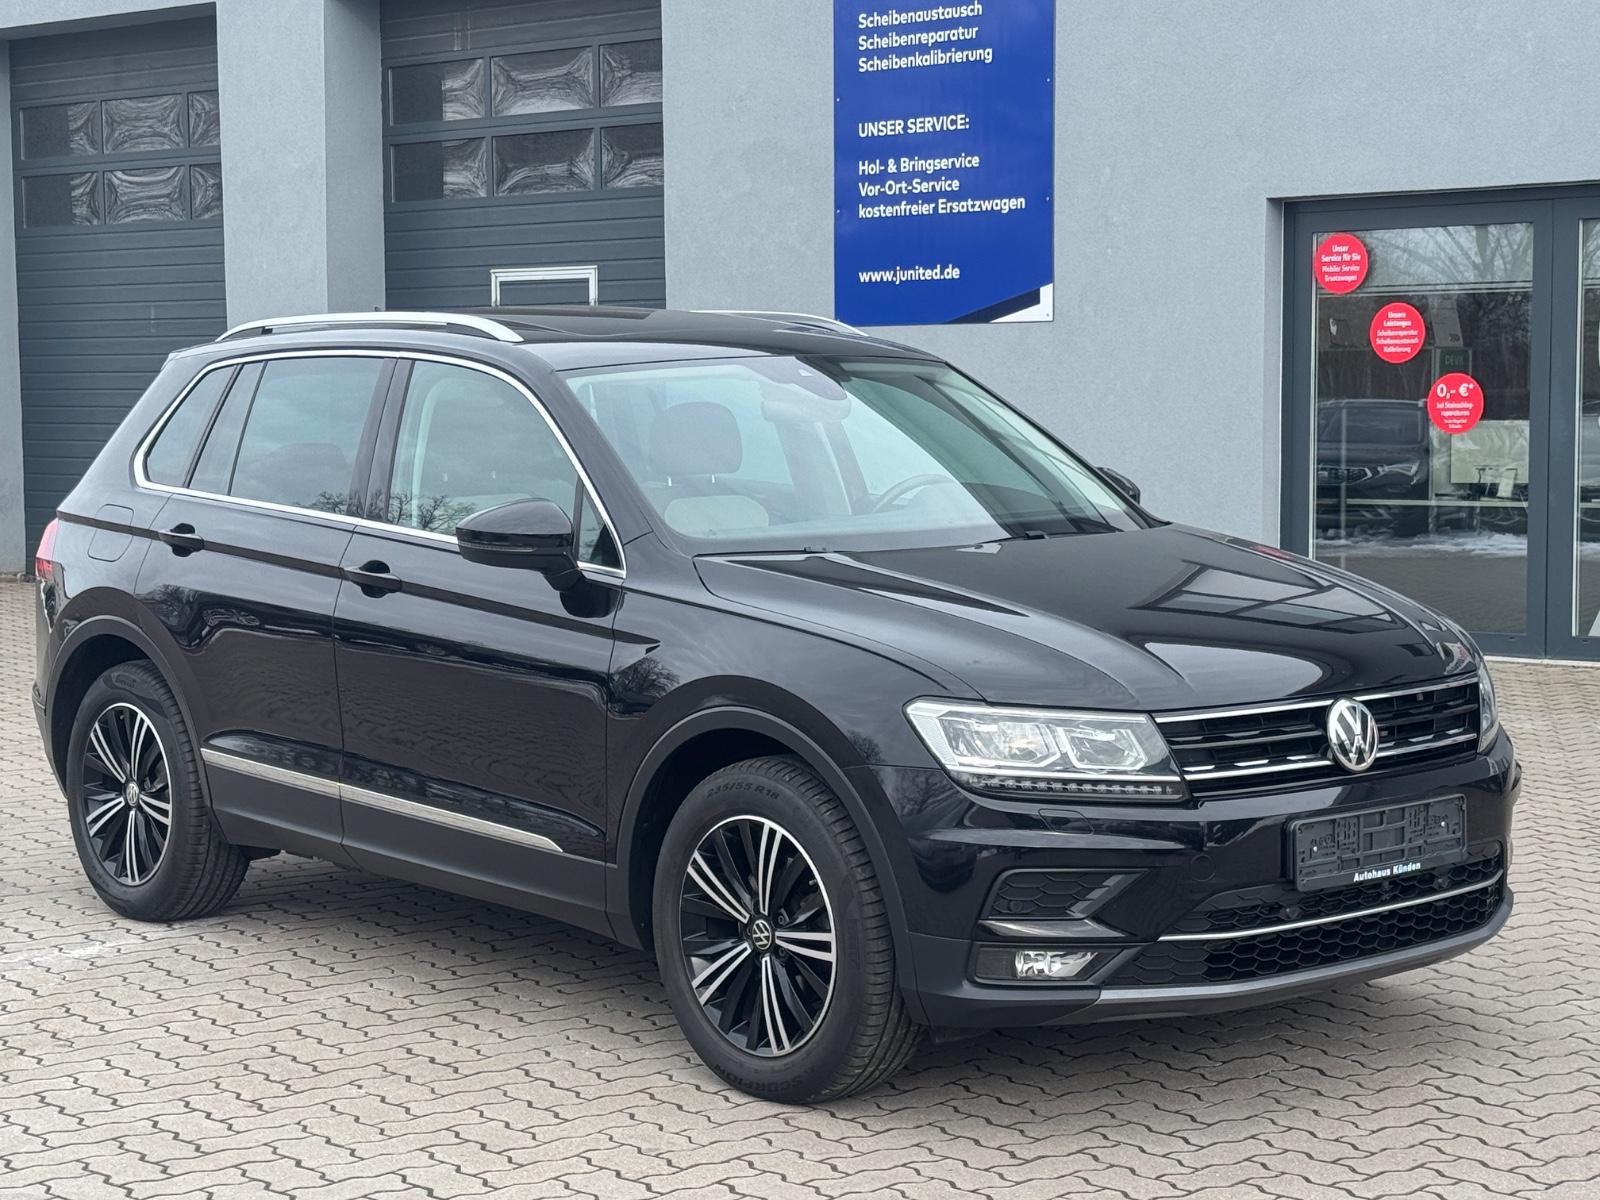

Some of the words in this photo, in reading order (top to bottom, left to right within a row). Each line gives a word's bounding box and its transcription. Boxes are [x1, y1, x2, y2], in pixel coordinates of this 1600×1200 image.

[858, 1, 983, 29] Scheibenaustausch
[858, 26, 979, 50] Scheibenreparatur
[858, 48, 993, 72] Scheibenkalibrierung
[858, 120, 904, 138] UNSER
[907, 114, 970, 134] SERVICE:
[858, 159, 884, 175] Hol-
[887, 158, 897, 173] &
[900, 153, 980, 174] Bringservice
[858, 177, 960, 197] Vor-Ort-Service
[858, 201, 935, 218] kostenfreier
[938, 197, 1025, 214] Ersatzwagen
[858, 264, 960, 284] www.junited.de
[1436, 383, 1456, 400] 0,-
[1353, 869, 1391, 883] Autohaus
